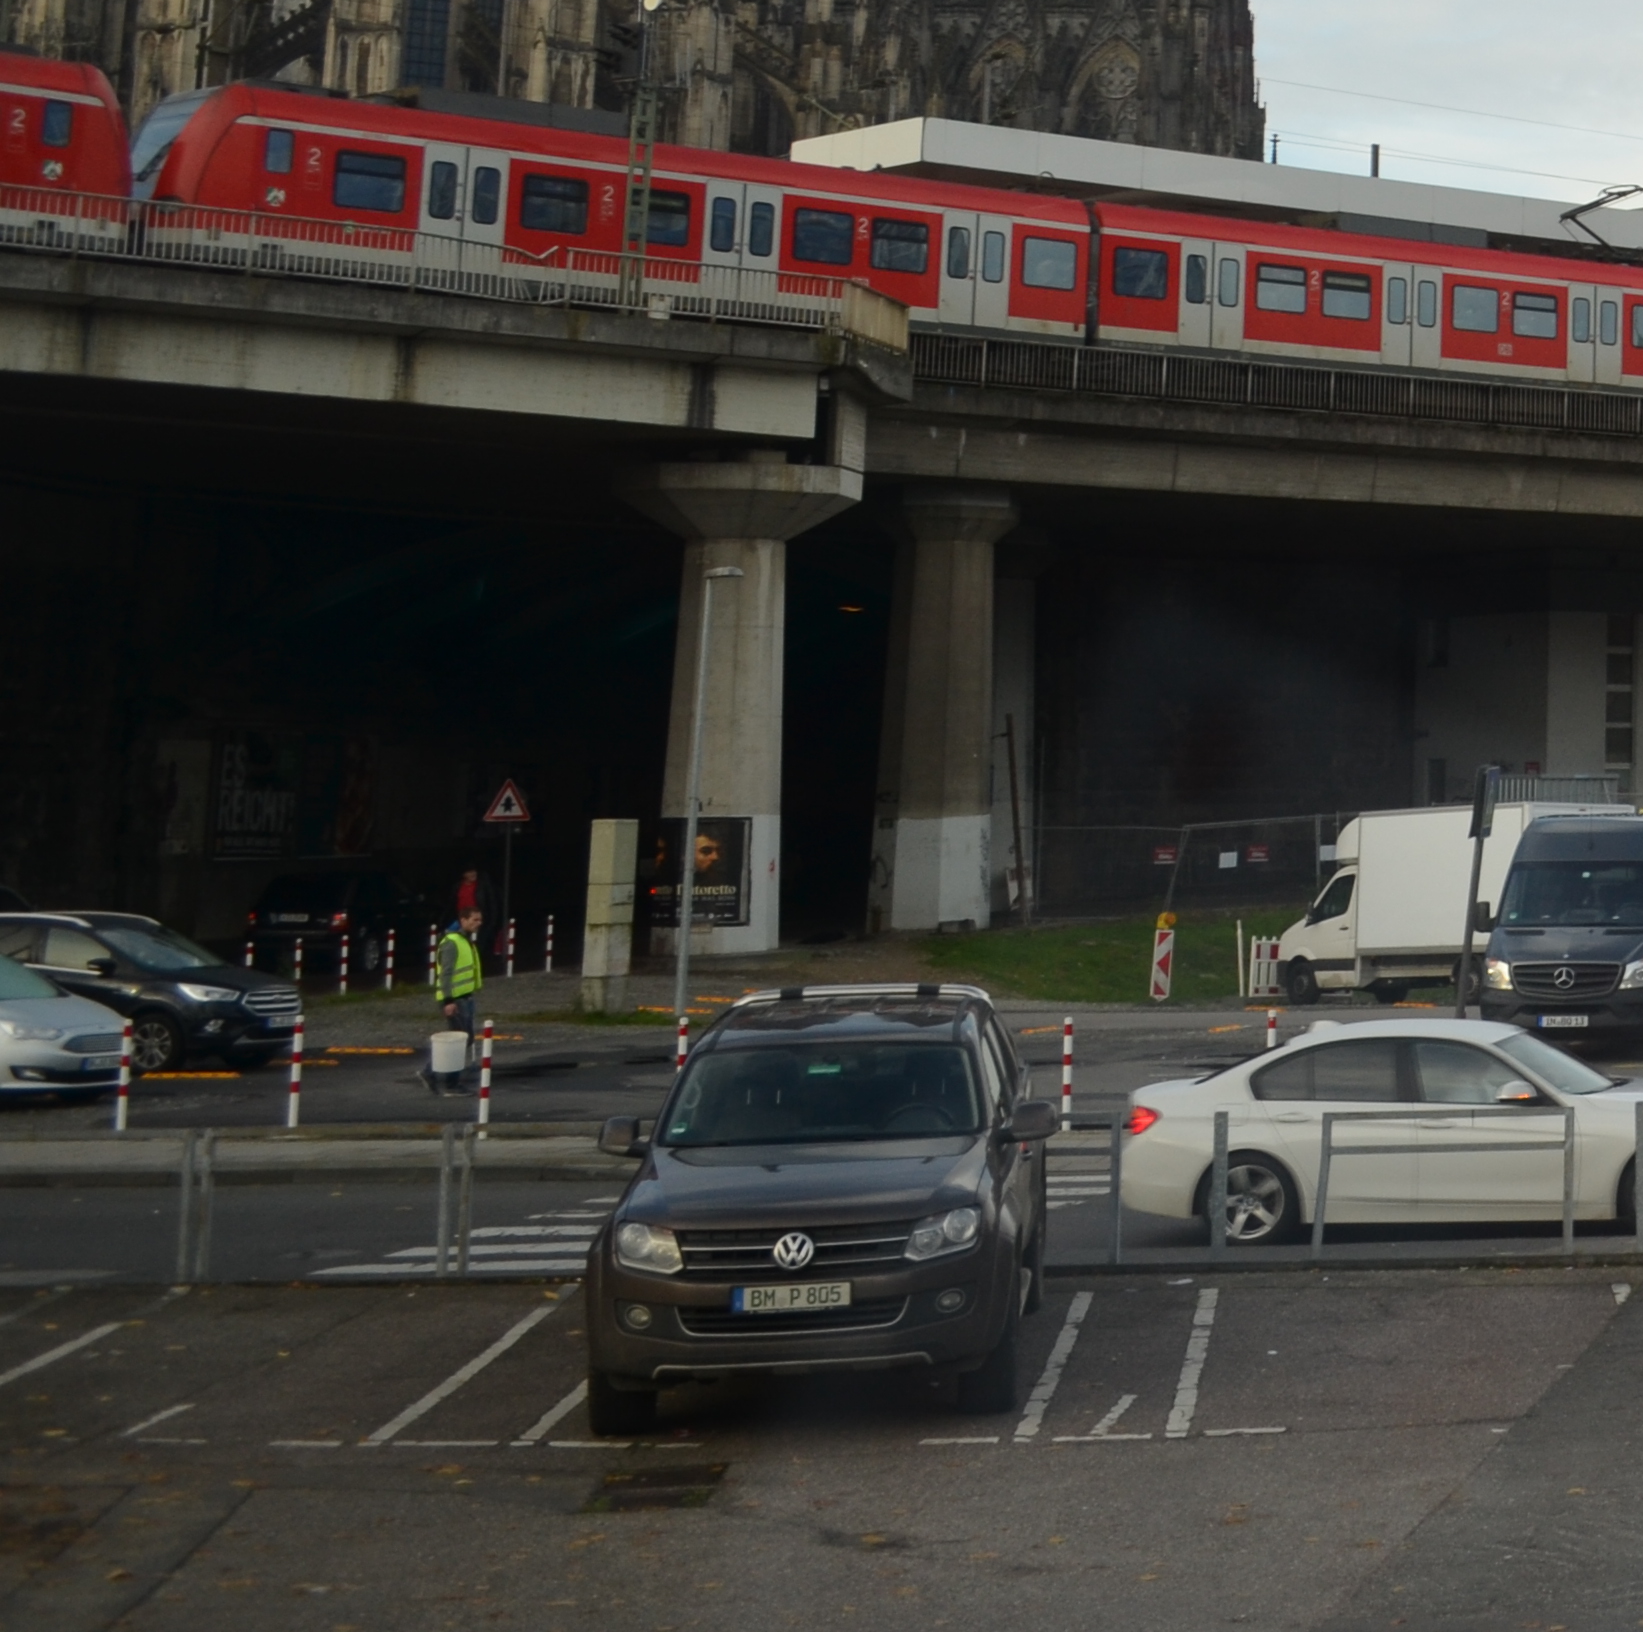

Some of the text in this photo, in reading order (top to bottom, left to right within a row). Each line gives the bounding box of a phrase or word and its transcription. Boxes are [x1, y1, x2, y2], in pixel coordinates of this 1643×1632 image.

[11, 109, 26, 130] 2
[308, 147, 321, 165] 2
[603, 185, 615, 202] 2
[858, 217, 869, 233] 2
[1310, 270, 1320, 285] 2
[1502, 291, 1511, 306] 2
[221, 743, 247, 788] ES
[750, 1284, 843, 1307] BM P 805
